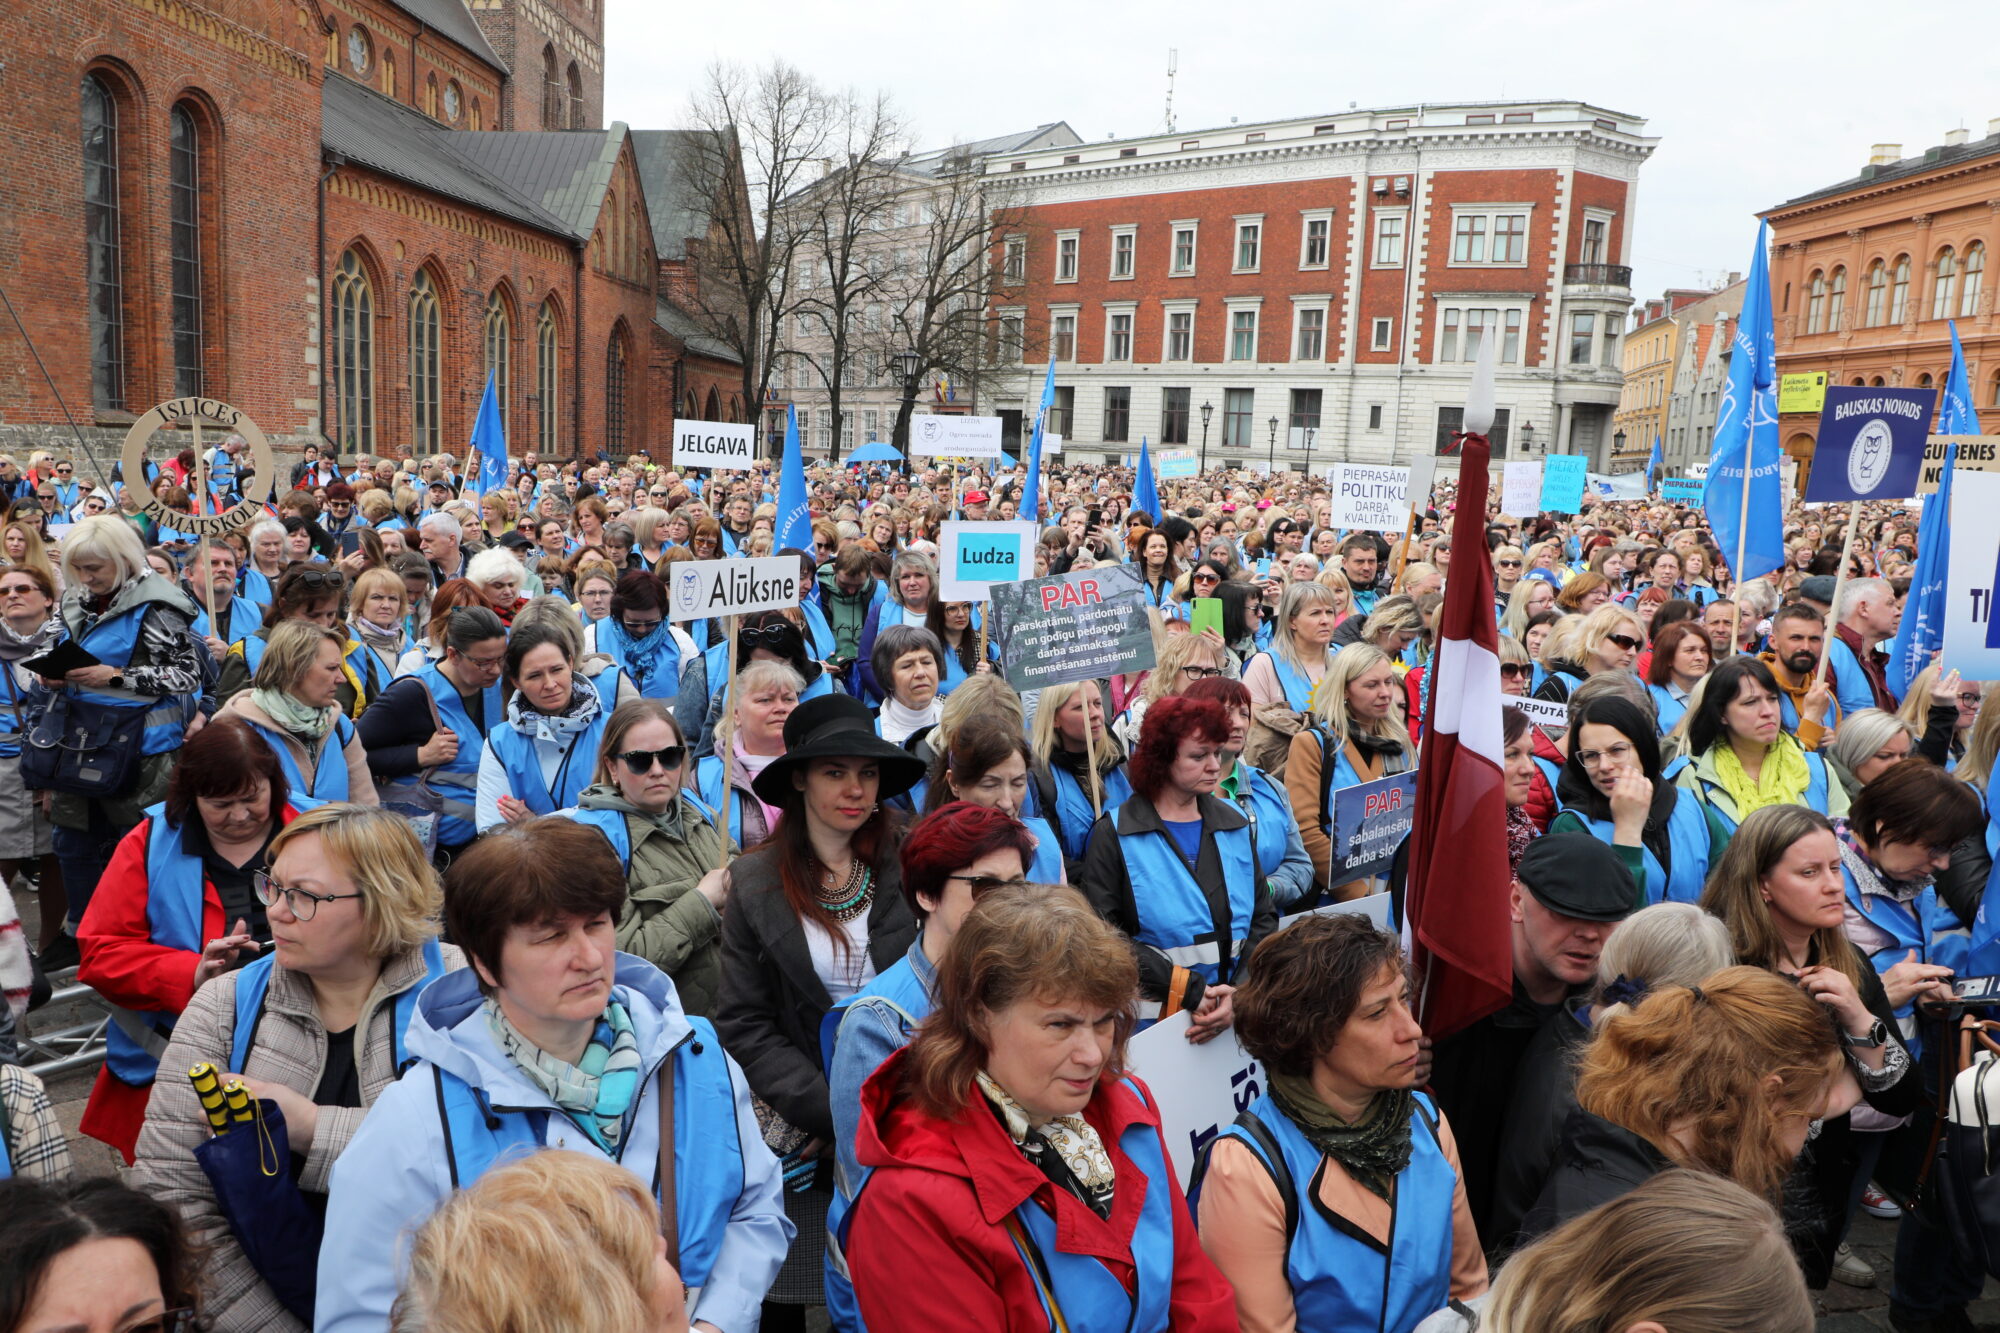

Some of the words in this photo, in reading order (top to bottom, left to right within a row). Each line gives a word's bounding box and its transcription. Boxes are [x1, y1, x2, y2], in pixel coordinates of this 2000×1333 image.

[1835, 398, 1883, 421] BAUSKAS
[1883, 398, 1923, 421] NOVADS
[679, 434, 747, 456] JELGAVA
[1343, 468, 1406, 484] PIEPRASĀM
[1341, 482, 1408, 503] POLITIĶU
[142, 499, 264, 538] PAMATSKOLA
[1344, 512, 1398, 526] KVALITĀTI!
[1355, 501, 1389, 513] DARBA
[962, 547, 1015, 564] Ludza
[708, 566, 794, 608] Alūksne
[1040, 579, 1103, 613] PAR
[1013, 615, 1077, 635] pārskatāmu,
[1078, 604, 1133, 623] pārdomātu
[1024, 637, 1038, 646] un
[1040, 630, 1075, 645] godīgu
[1077, 621, 1127, 640] pedagogu
[1037, 645, 1067, 659] darba
[1068, 637, 1120, 653] samaksas
[1024, 657, 1092, 677] finansēšanas
[1093, 648, 1137, 665] sistēmu!
[1515, 701, 1568, 718] DEPUTĀ
[1365, 787, 1402, 819] PAR
[1348, 817, 1413, 847] sabalansētu
[1345, 850, 1377, 870] darba
[1378, 839, 1402, 859] slo
